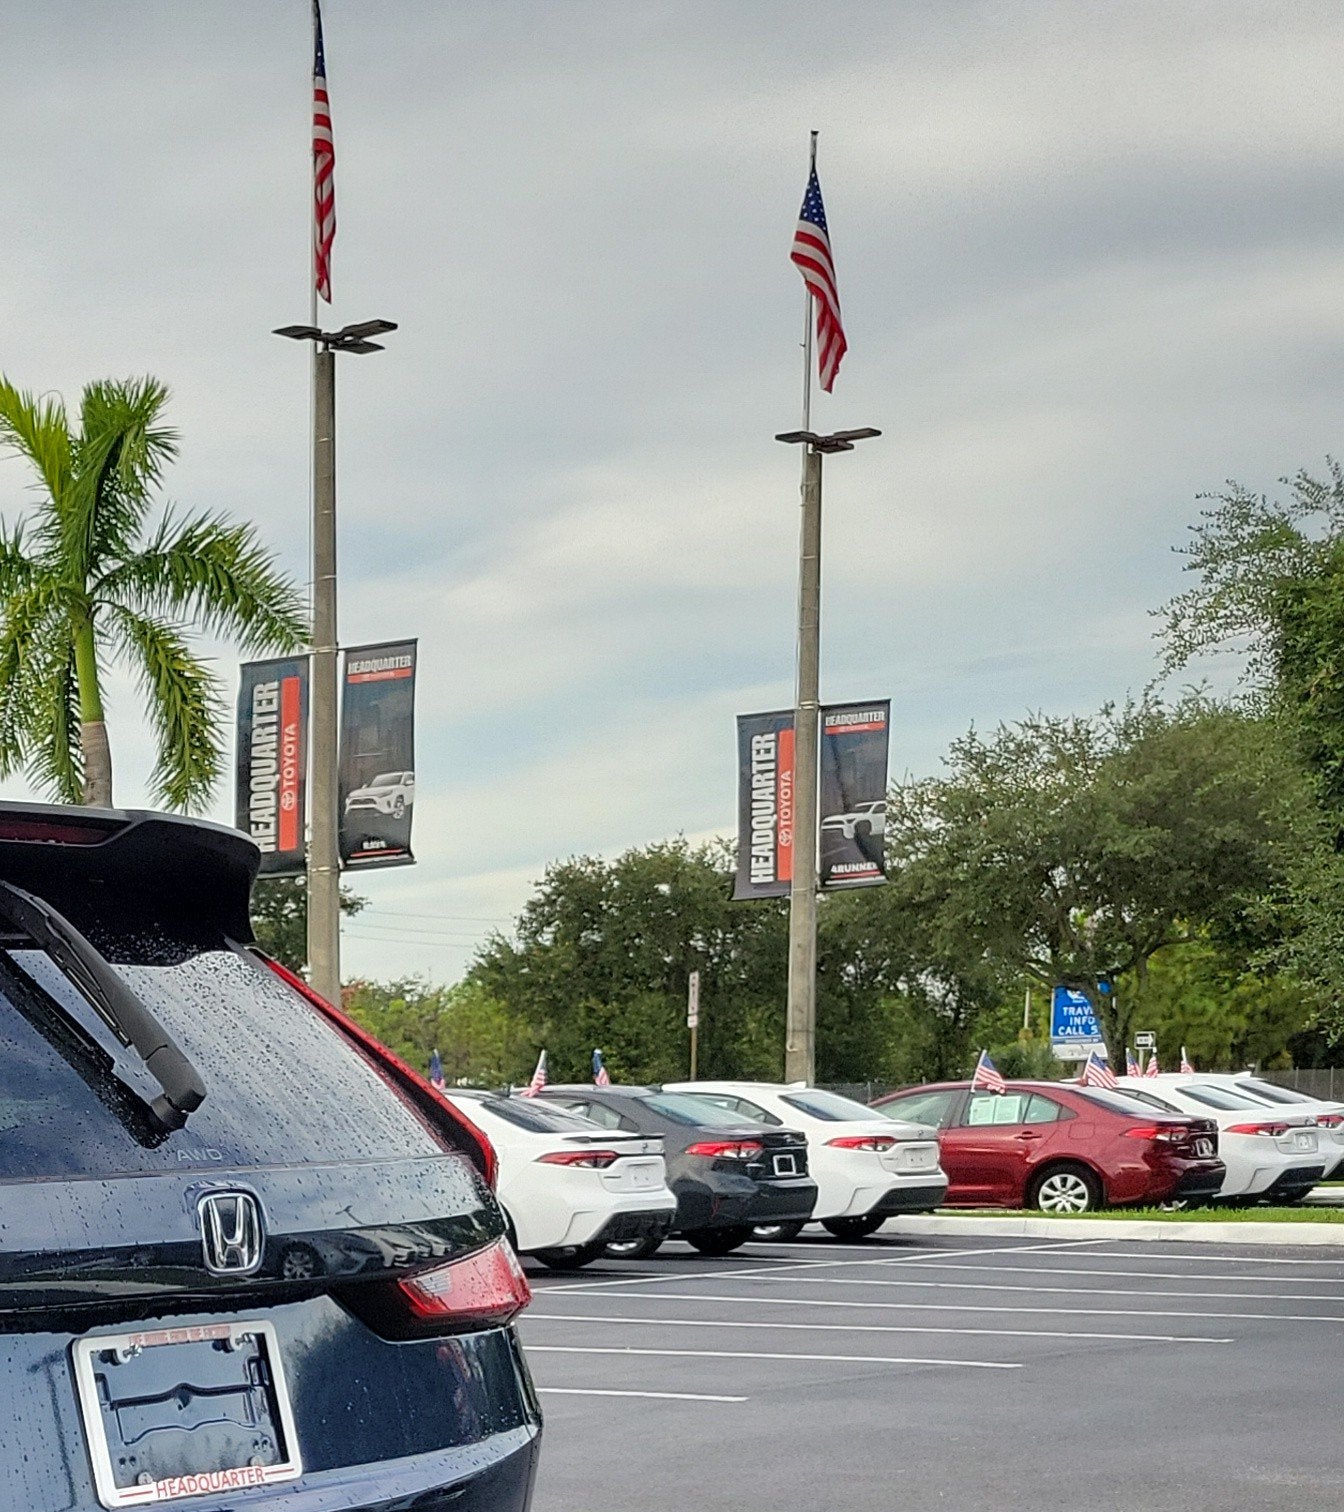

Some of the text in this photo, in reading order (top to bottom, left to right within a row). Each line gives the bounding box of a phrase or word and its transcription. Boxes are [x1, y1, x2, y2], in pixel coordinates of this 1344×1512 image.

[249, 680, 279, 853] HEADQUARTER
[282, 723, 297, 788] TOYOTA
[750, 732, 777, 884] HEADQUARTER
[779, 770, 793, 828] TOYOTA
[1058, 1025, 1084, 1036] CALL
[177, 1148, 223, 1162] AWD
[155, 1466, 265, 1499] HEADQUARTER
